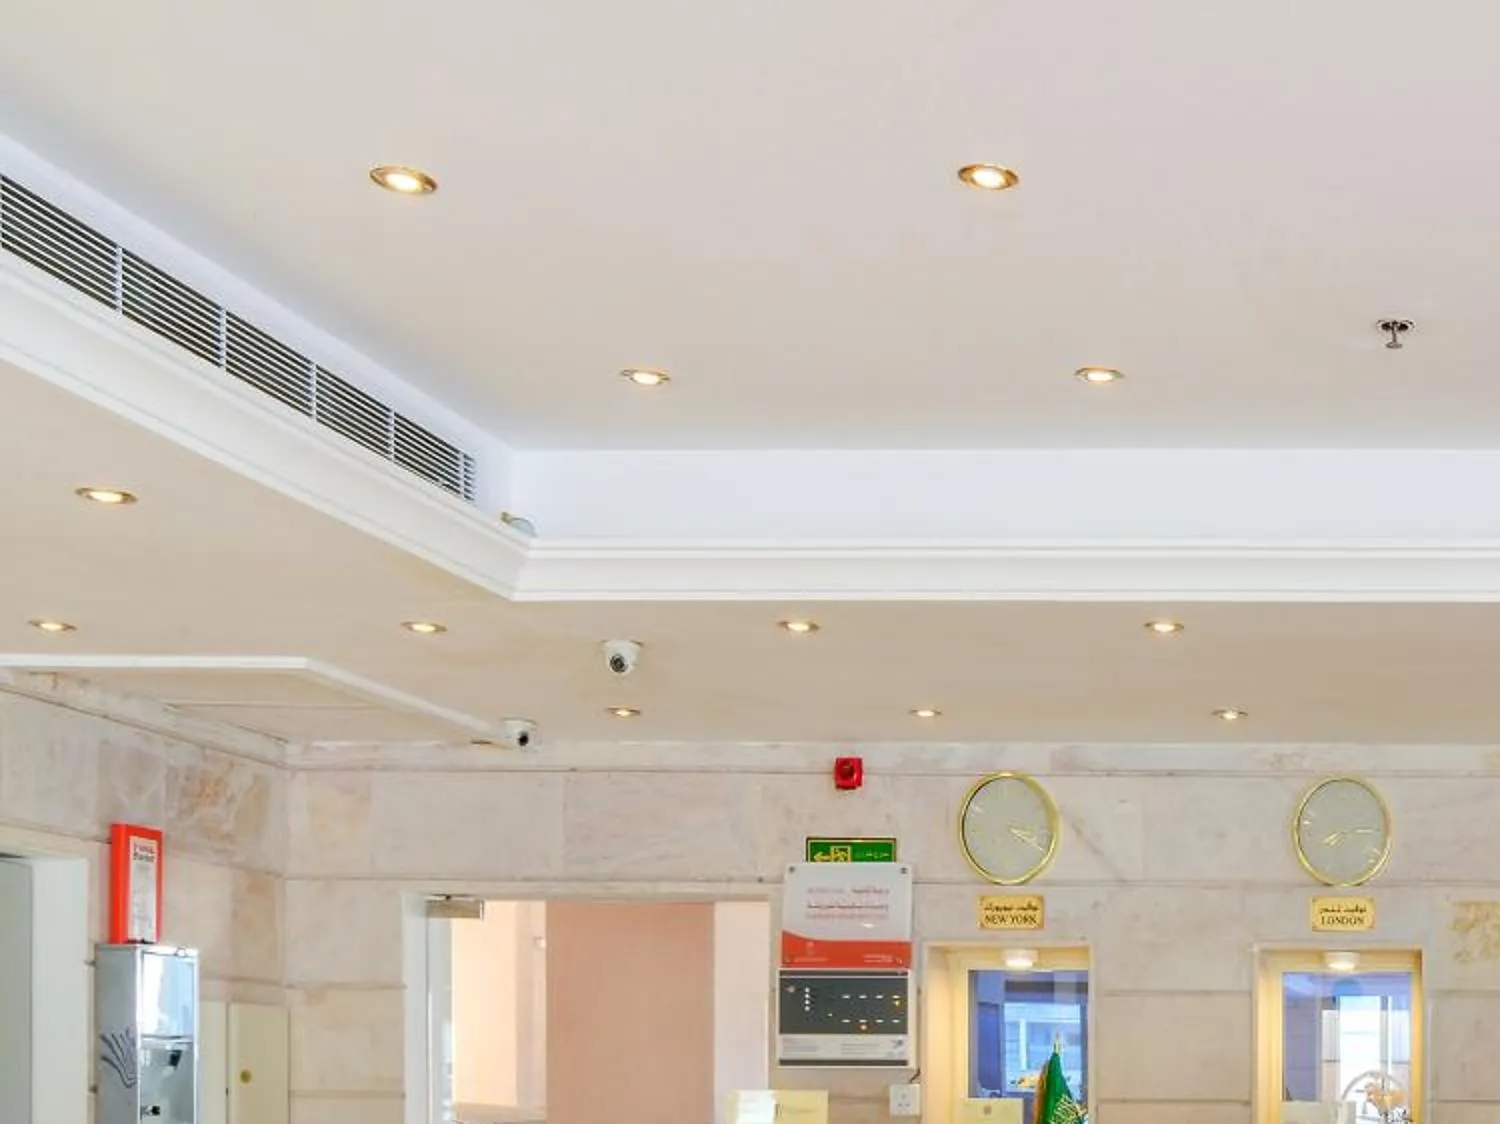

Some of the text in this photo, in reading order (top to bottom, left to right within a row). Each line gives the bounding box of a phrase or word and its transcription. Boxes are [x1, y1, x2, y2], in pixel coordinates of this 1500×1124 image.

[984, 914, 1037, 925] NEW YORK
[1321, 915, 1365, 925] LONDON
